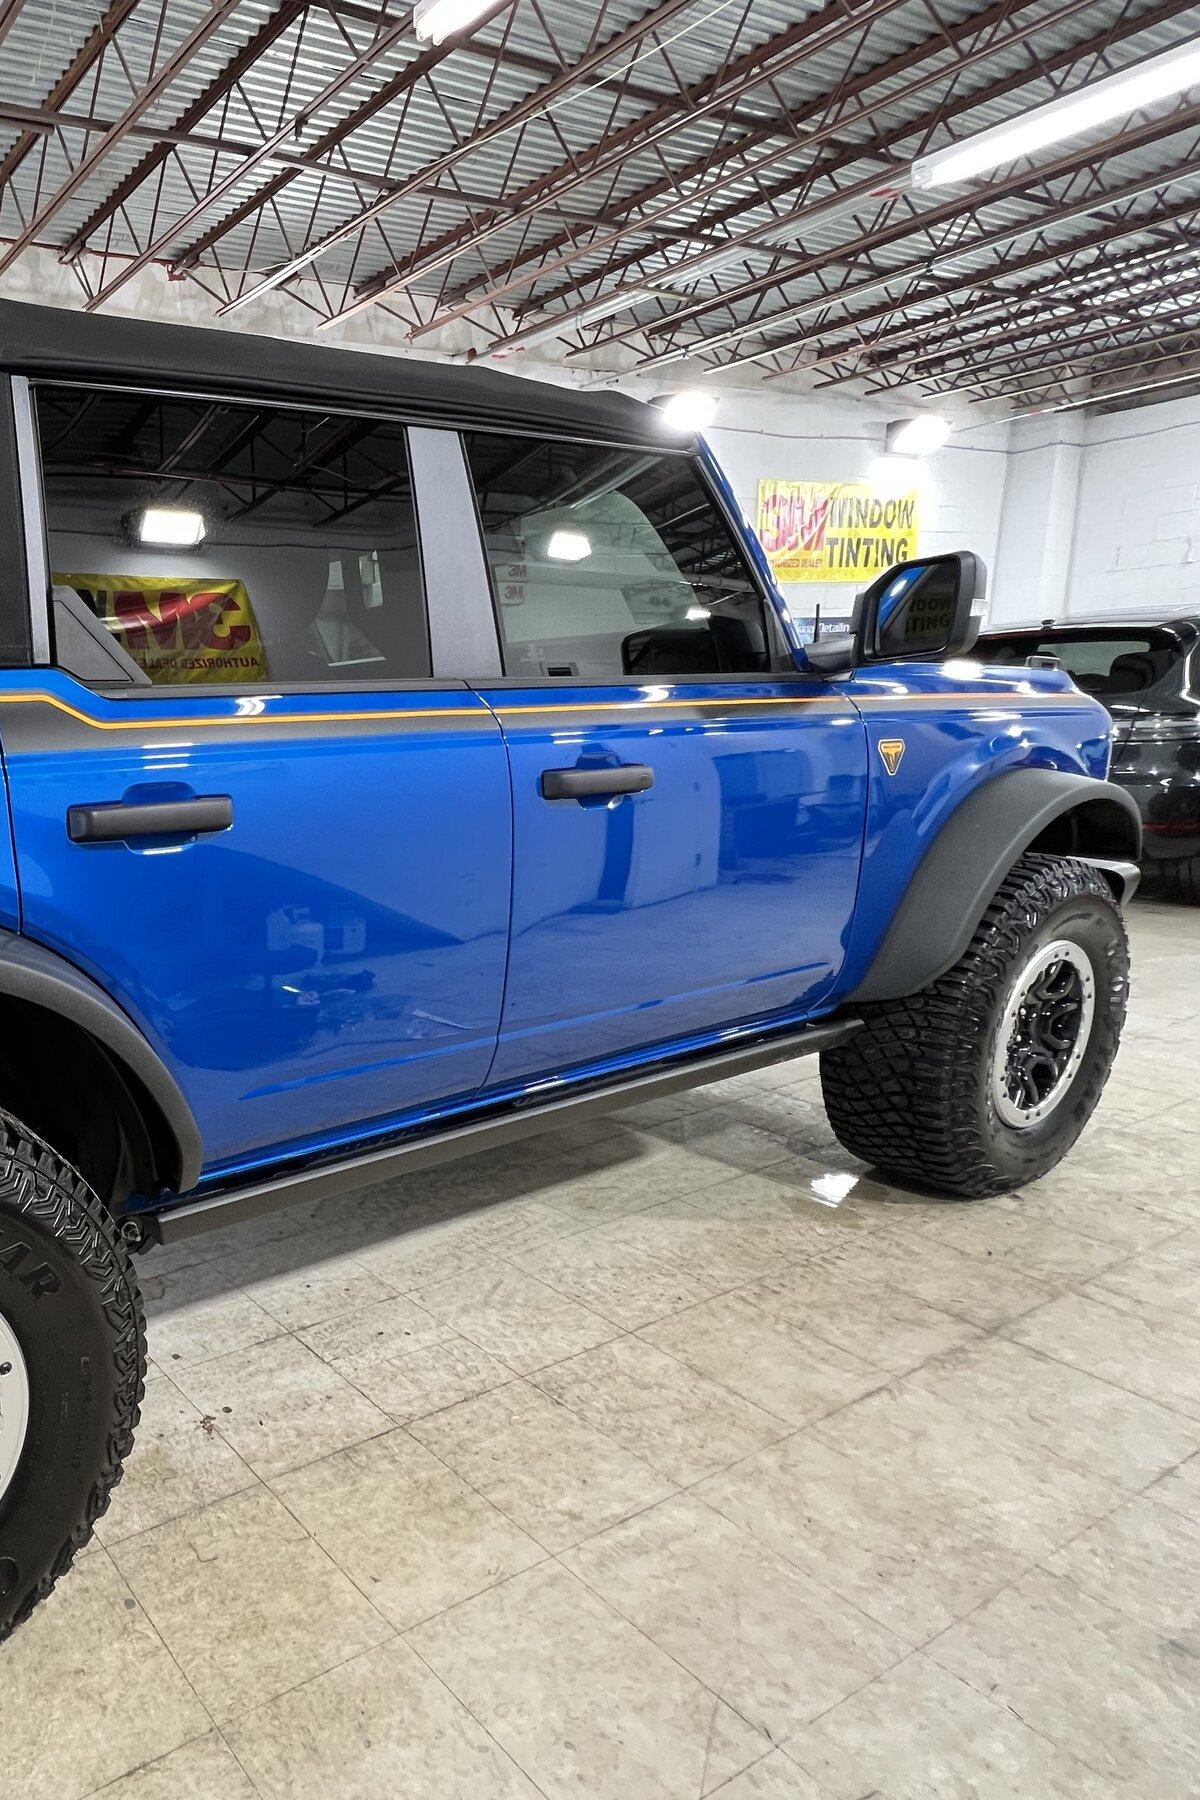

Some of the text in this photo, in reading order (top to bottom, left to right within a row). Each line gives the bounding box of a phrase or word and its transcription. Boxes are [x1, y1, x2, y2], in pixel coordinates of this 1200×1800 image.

[829, 497, 915, 529] WINDOW
[826, 537, 909, 568] TINTING
[909, 597, 953, 612] DOW
